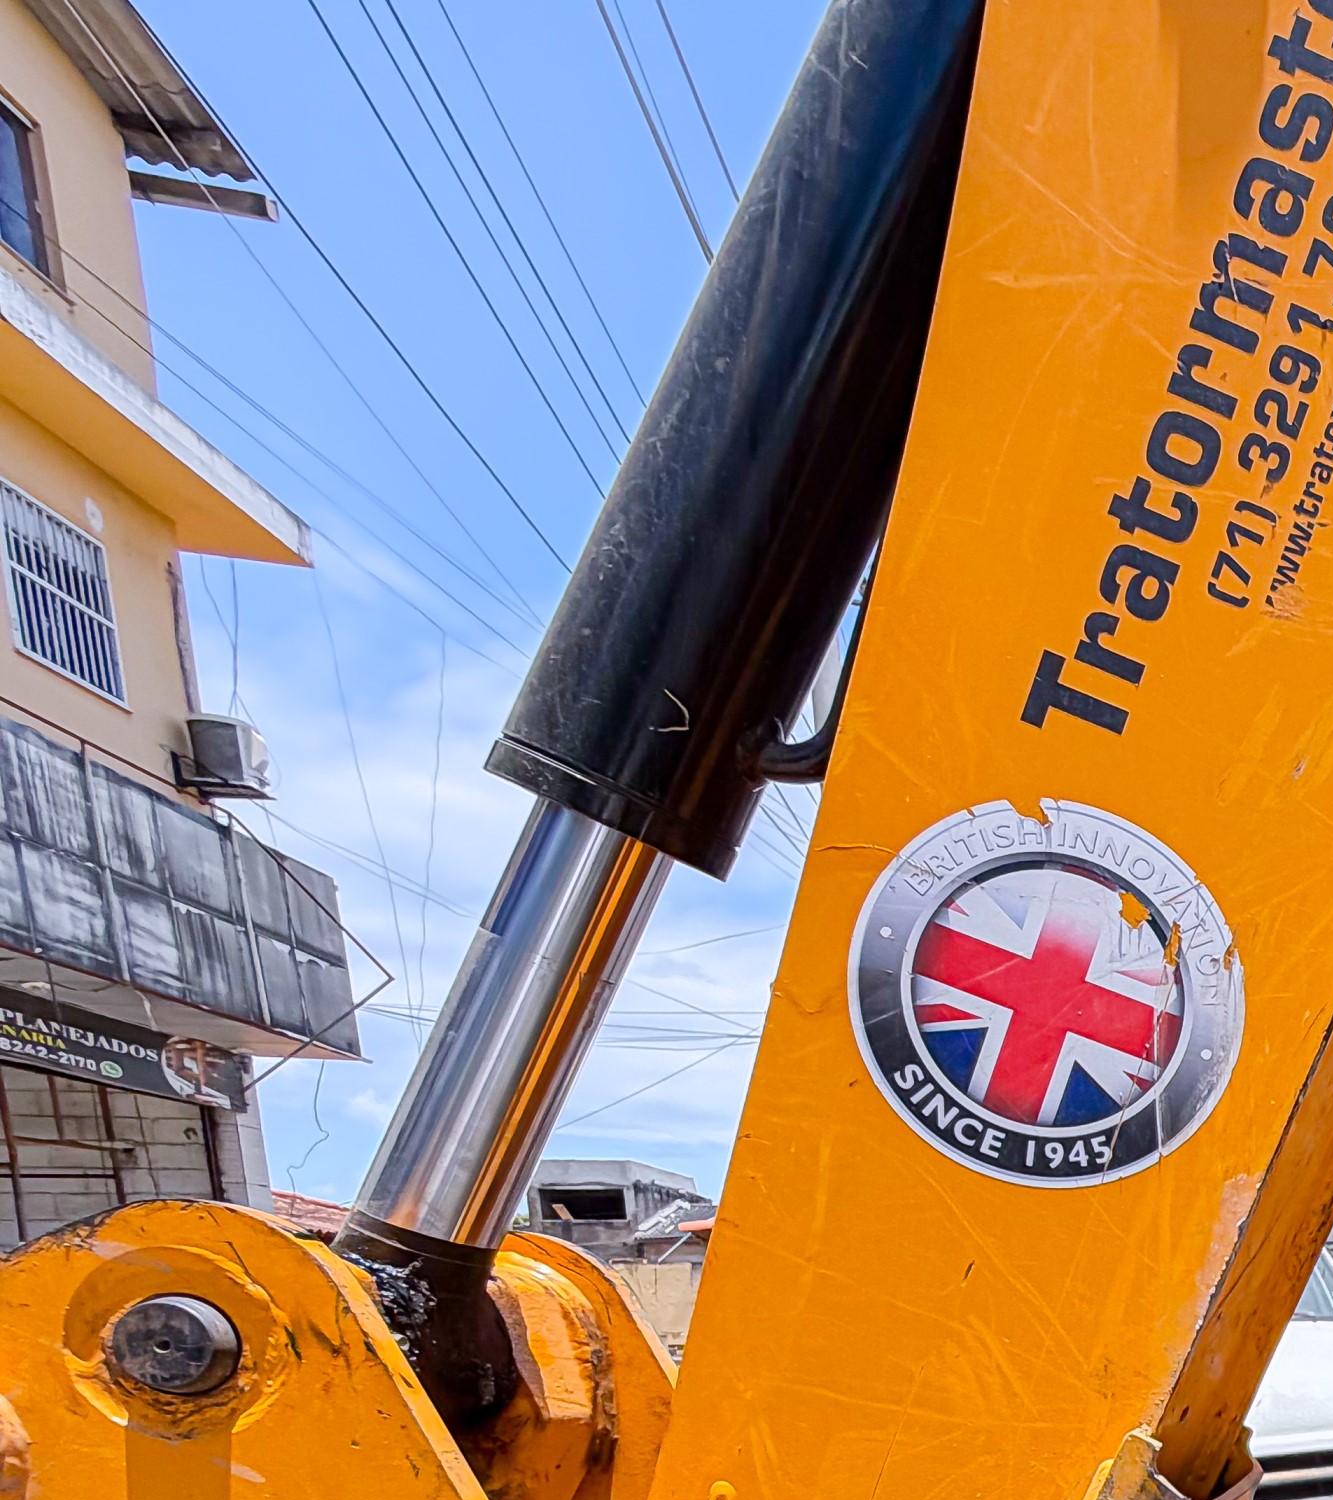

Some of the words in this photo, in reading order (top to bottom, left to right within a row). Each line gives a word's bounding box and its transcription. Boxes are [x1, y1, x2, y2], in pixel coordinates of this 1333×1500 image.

[1207, 500, 1278, 609] (71)
[903, 817, 1044, 897] BRITISH
[0, 1022, 67, 1050] NARIA
[893, 1063, 1008, 1159] SINCE
[1025, 1135, 1113, 1169] 1945
